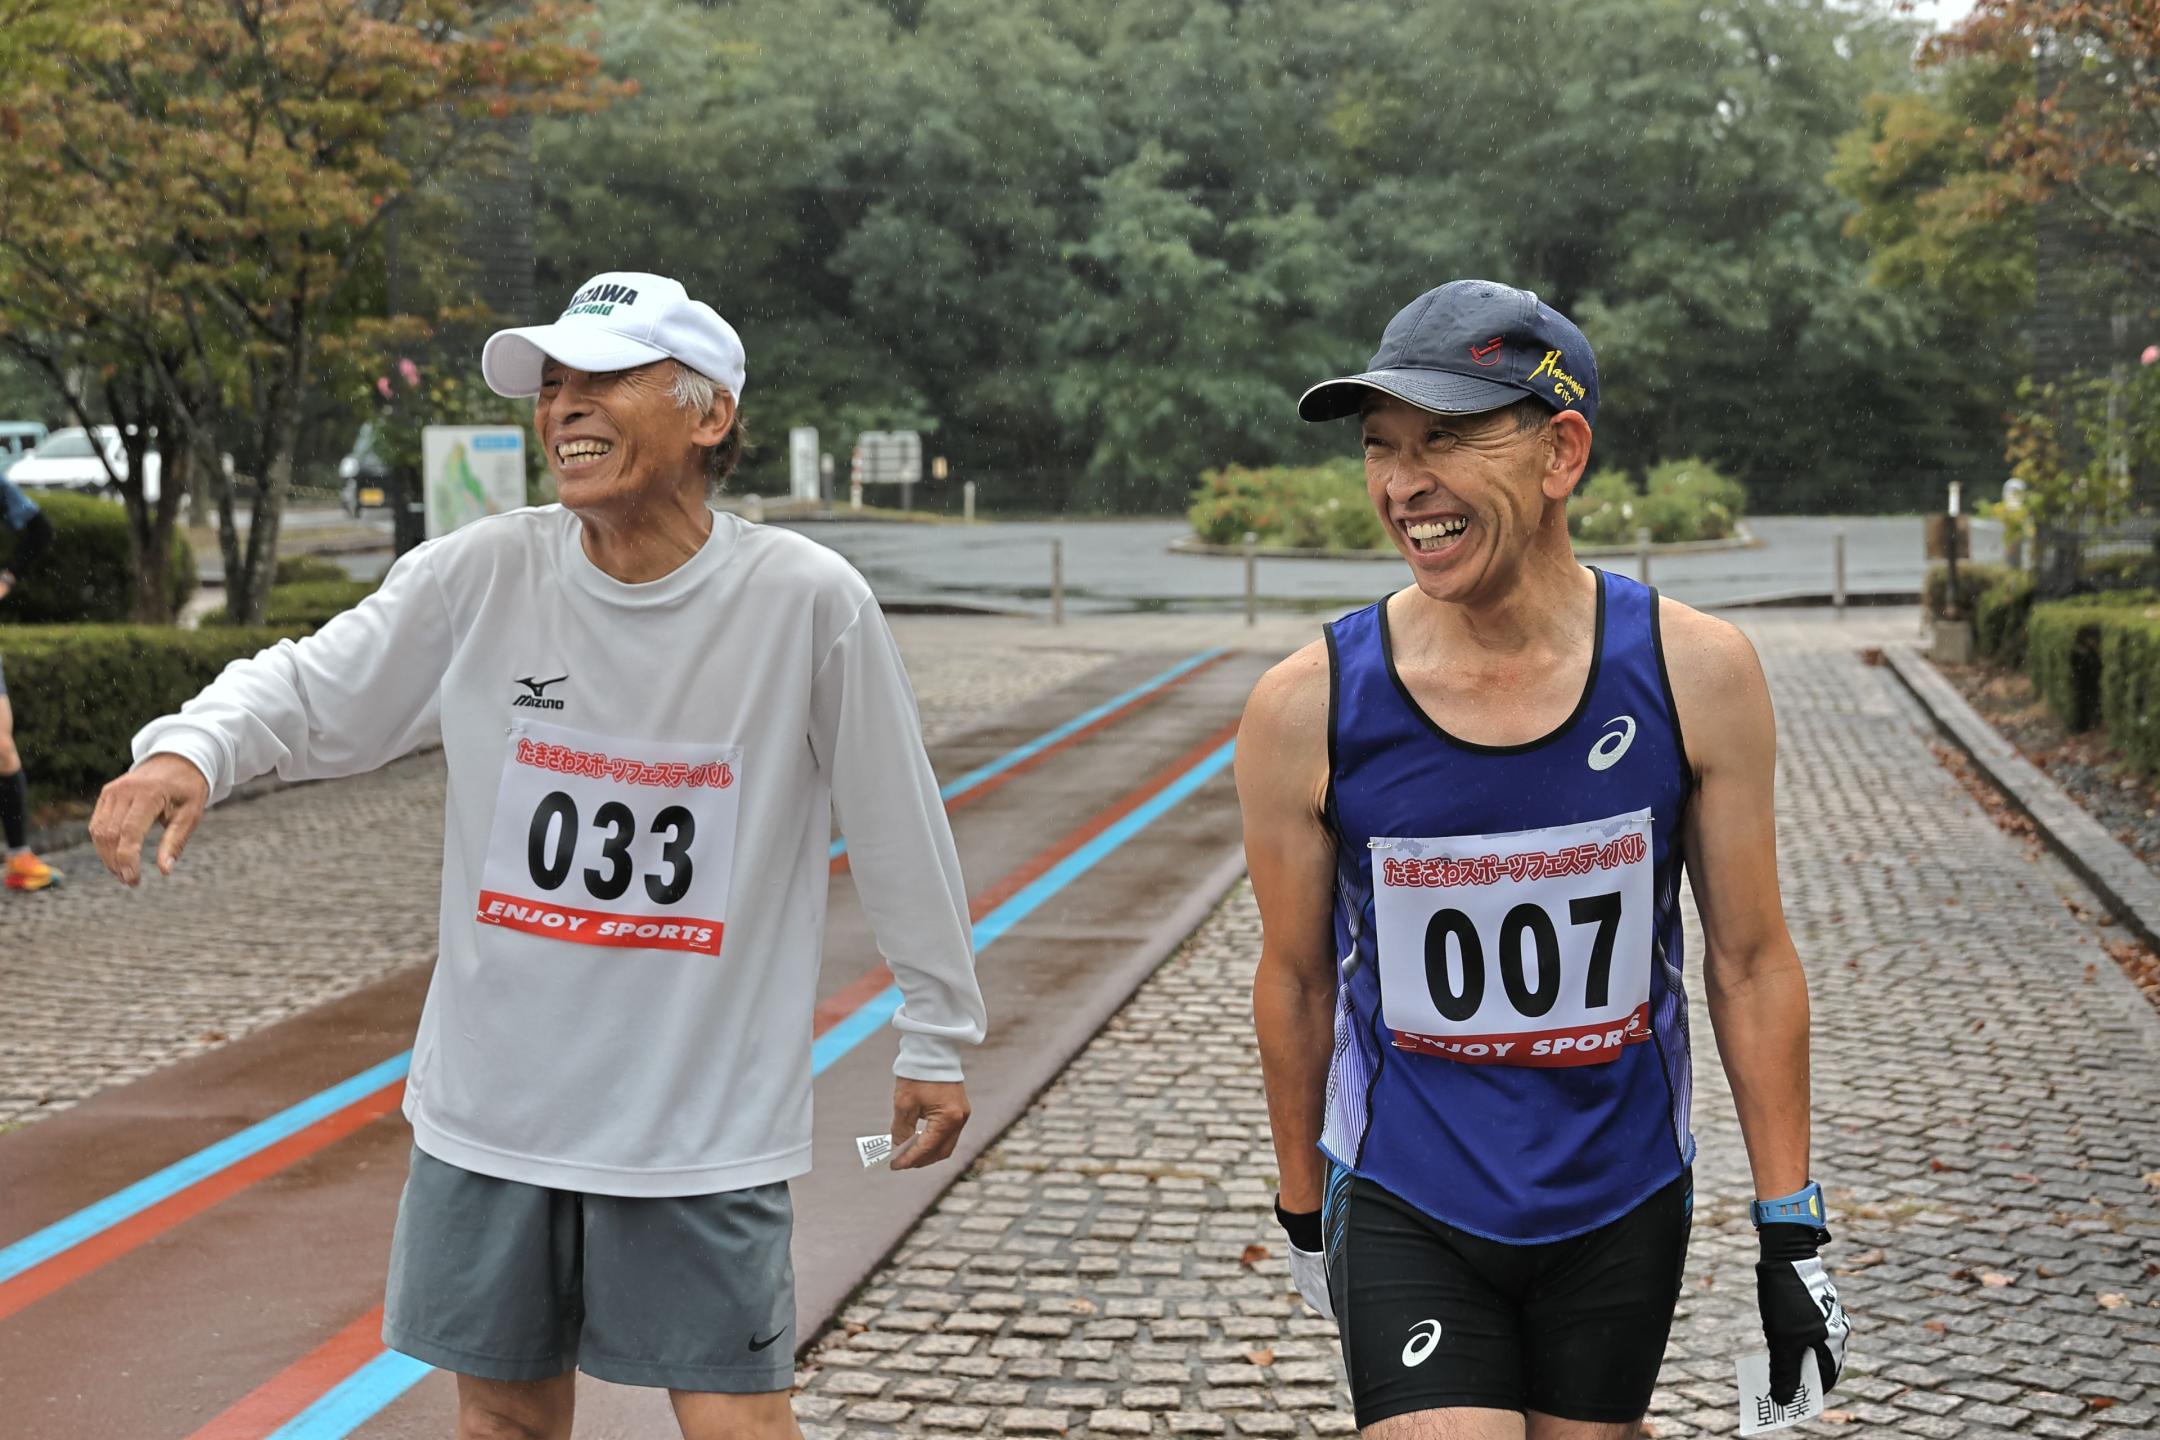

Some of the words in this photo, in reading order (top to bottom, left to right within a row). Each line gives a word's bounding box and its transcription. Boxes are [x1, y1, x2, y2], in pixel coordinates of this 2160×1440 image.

[512, 694, 565, 711] MIZUNO
[515, 738, 735, 790] たきざわスポーツフェスティバル
[528, 790, 696, 906] 033
[1383, 832, 1648, 888] たきざわスポーツフェスティバル
[487, 899, 589, 932] ENJOY
[597, 920, 713, 944] SPORTS
[1424, 890, 1622, 1022] 007
[1529, 1012, 1640, 1056] SPORS
